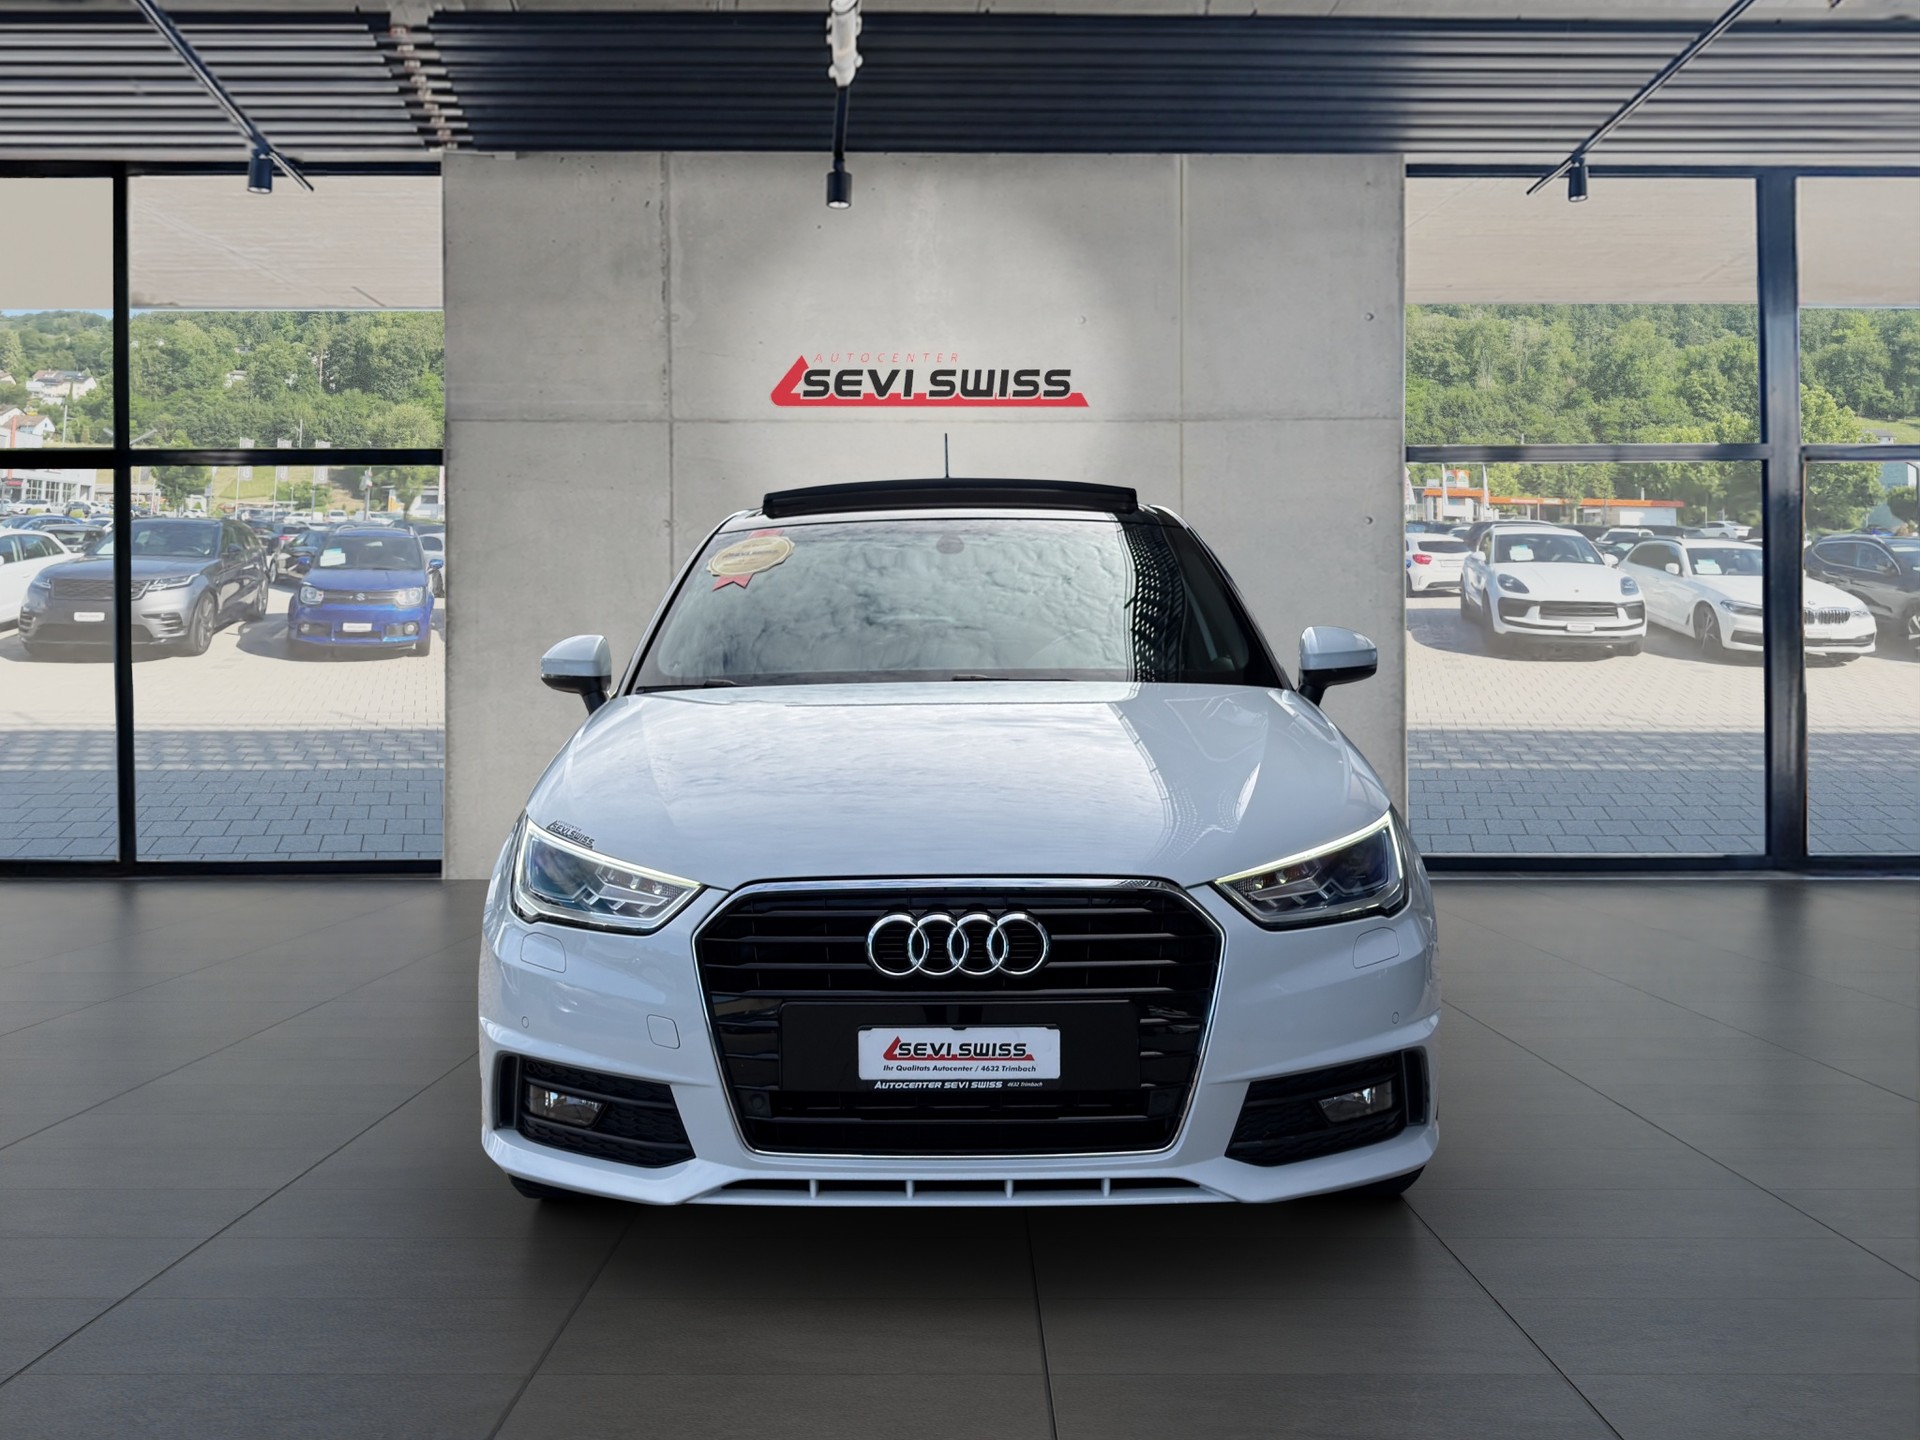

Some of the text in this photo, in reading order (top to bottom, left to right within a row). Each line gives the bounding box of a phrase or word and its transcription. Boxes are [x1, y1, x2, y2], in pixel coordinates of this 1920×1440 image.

[813, 352, 959, 363] AUTOCENTER
[802, 369, 1072, 398] SEVI SWISS
[569, 830, 595, 846] SWISS
[898, 1042, 1027, 1057] SEVI SWISS
[883, 1064, 894, 1072] Ihr
[932, 1064, 973, 1072] Autocenter
[980, 1065, 1000, 1073] 4632
[1001, 1065, 1036, 1073] Trimbach
[944, 1081, 969, 1089] SEVI
[970, 1081, 1003, 1089] SWISS
